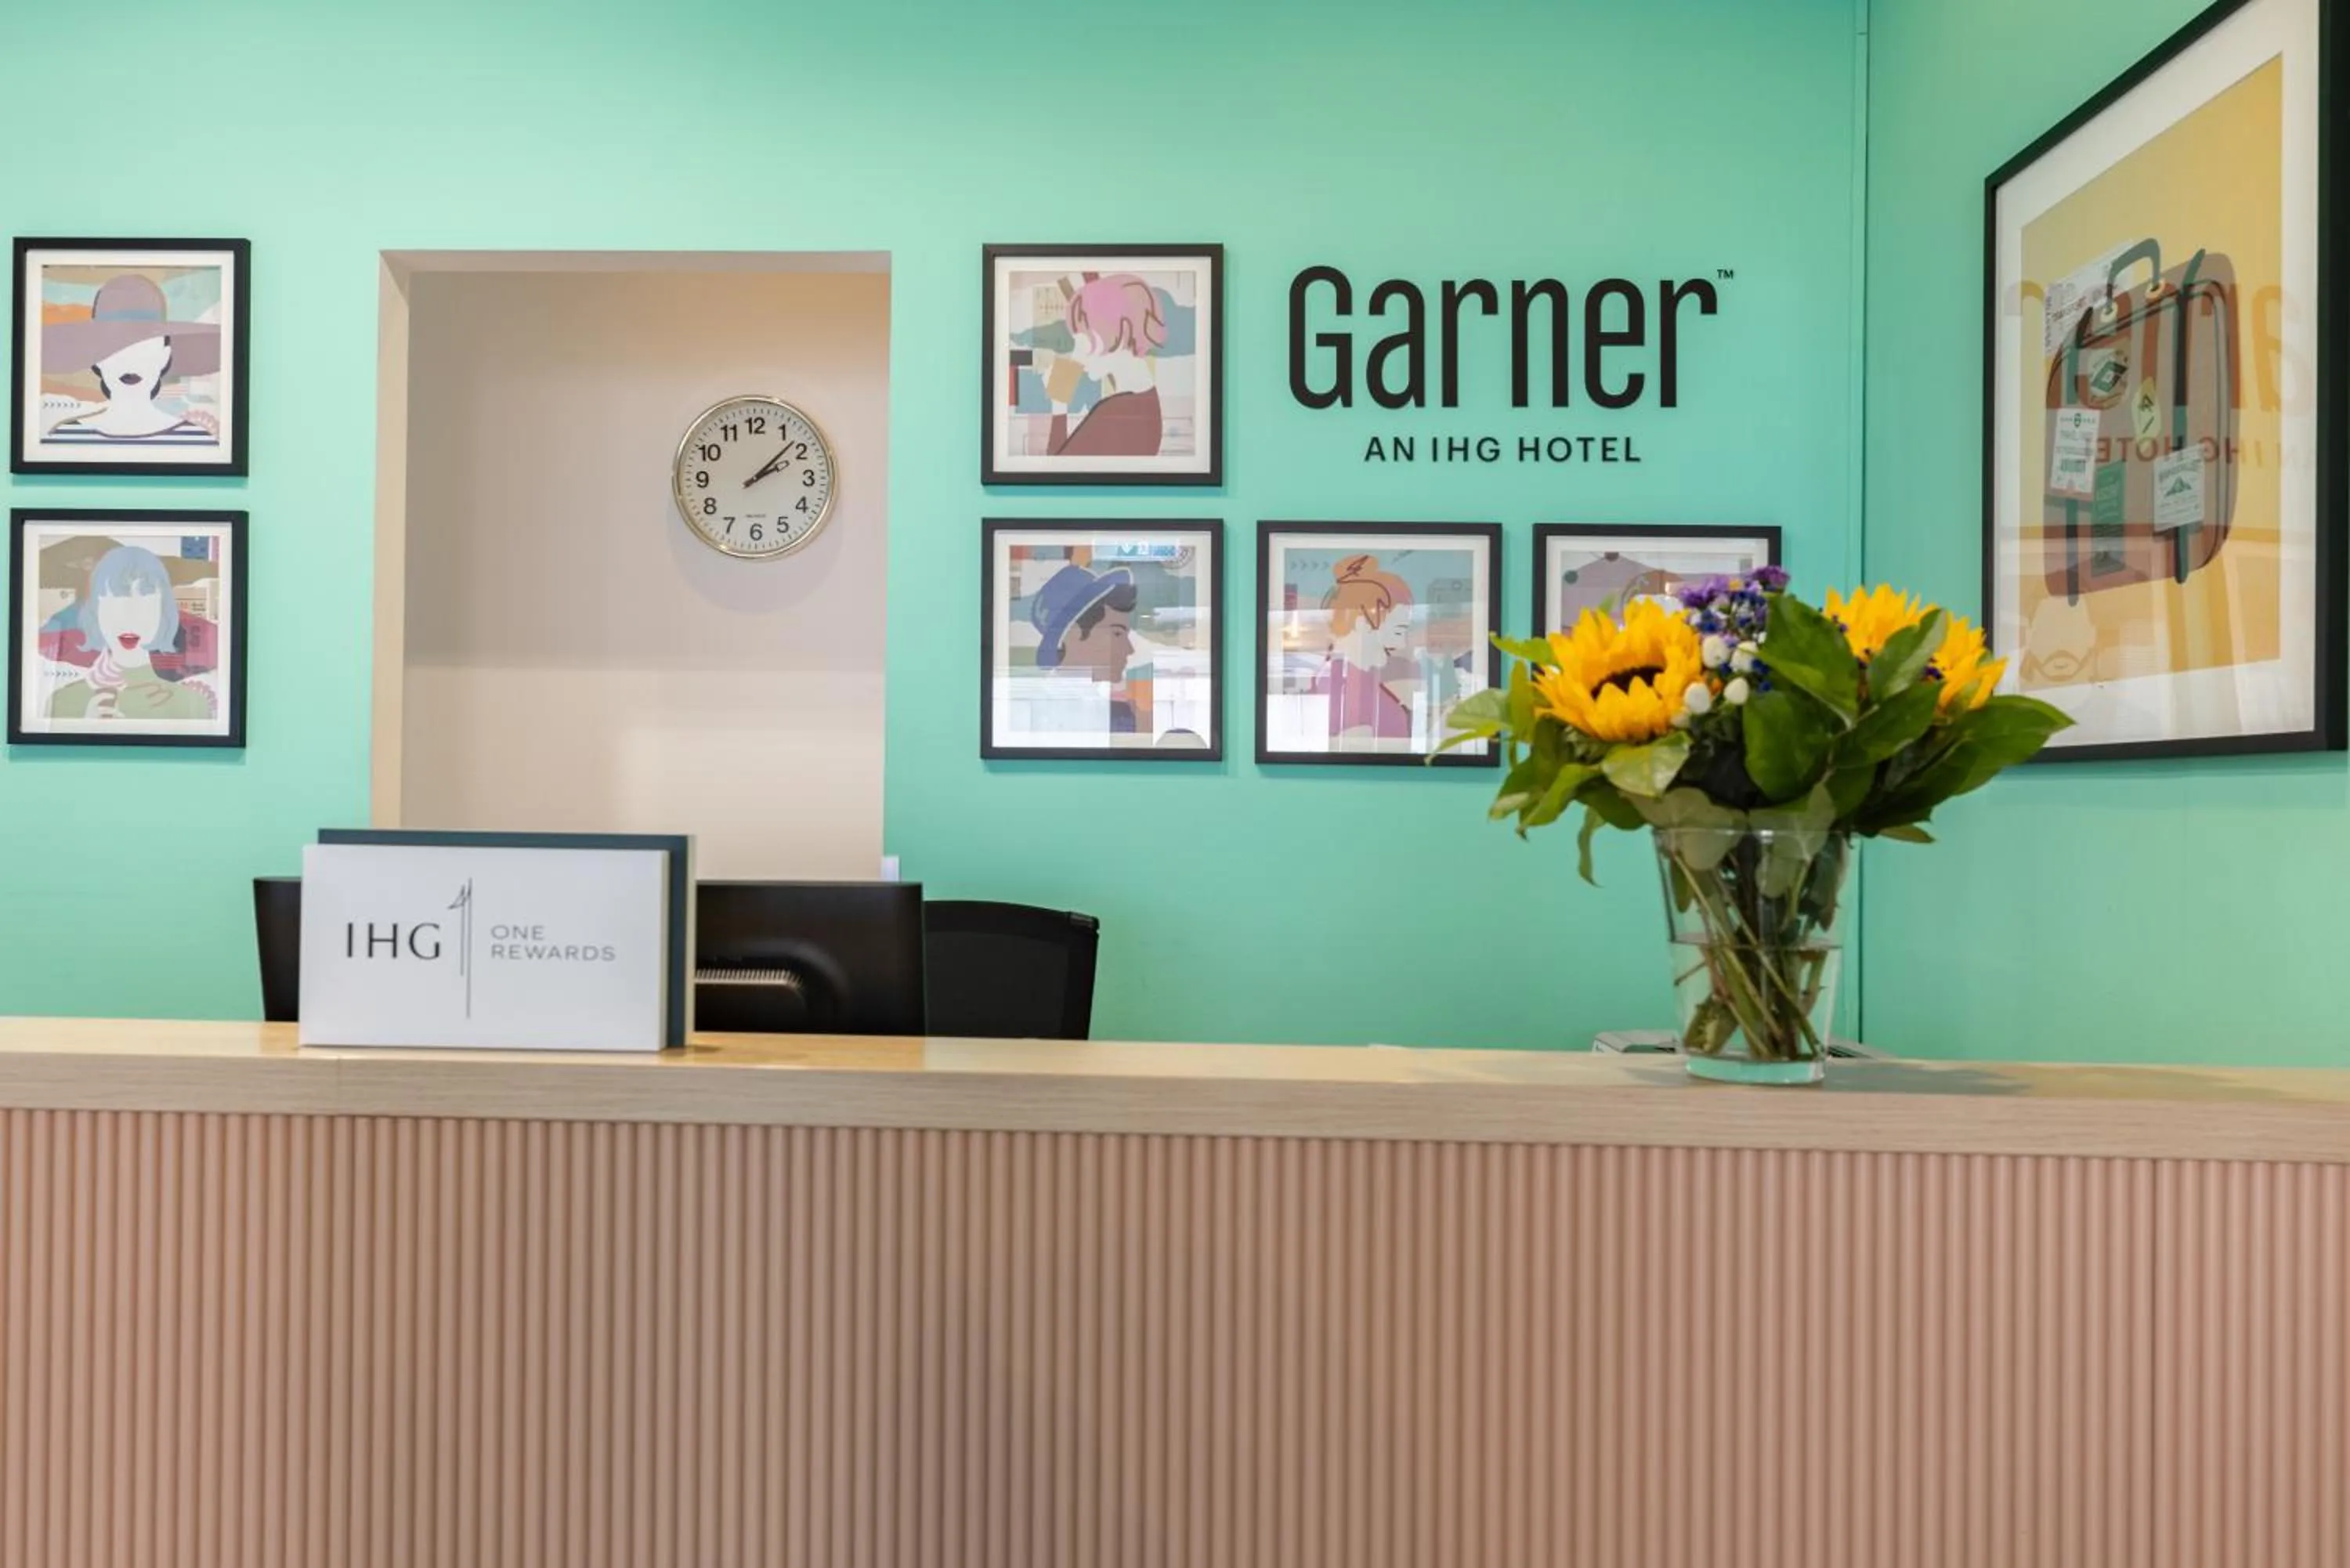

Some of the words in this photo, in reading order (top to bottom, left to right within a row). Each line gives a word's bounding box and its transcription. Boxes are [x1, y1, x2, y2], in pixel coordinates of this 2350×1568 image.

[720, 424, 739, 442] 11
[745, 417, 766, 435] 12
[778, 424, 786, 441] 1
[699, 443, 721, 461] 10
[795, 443, 808, 461] 2
[1364, 435, 1415, 463] AN
[1431, 435, 1501, 464] IHG
[1518, 436, 1642, 463] HOTEL
[696, 471, 710, 489] 9
[802, 469, 815, 487] 3
[703, 497, 717, 515] 8
[795, 496, 808, 513] 4
[722, 517, 736, 534] 7
[750, 523, 763, 541] 6
[776, 516, 790, 533] 5
[346, 922, 441, 961] IHG
[490, 925, 544, 941] ONE
[491, 944, 616, 962] REWARDS
